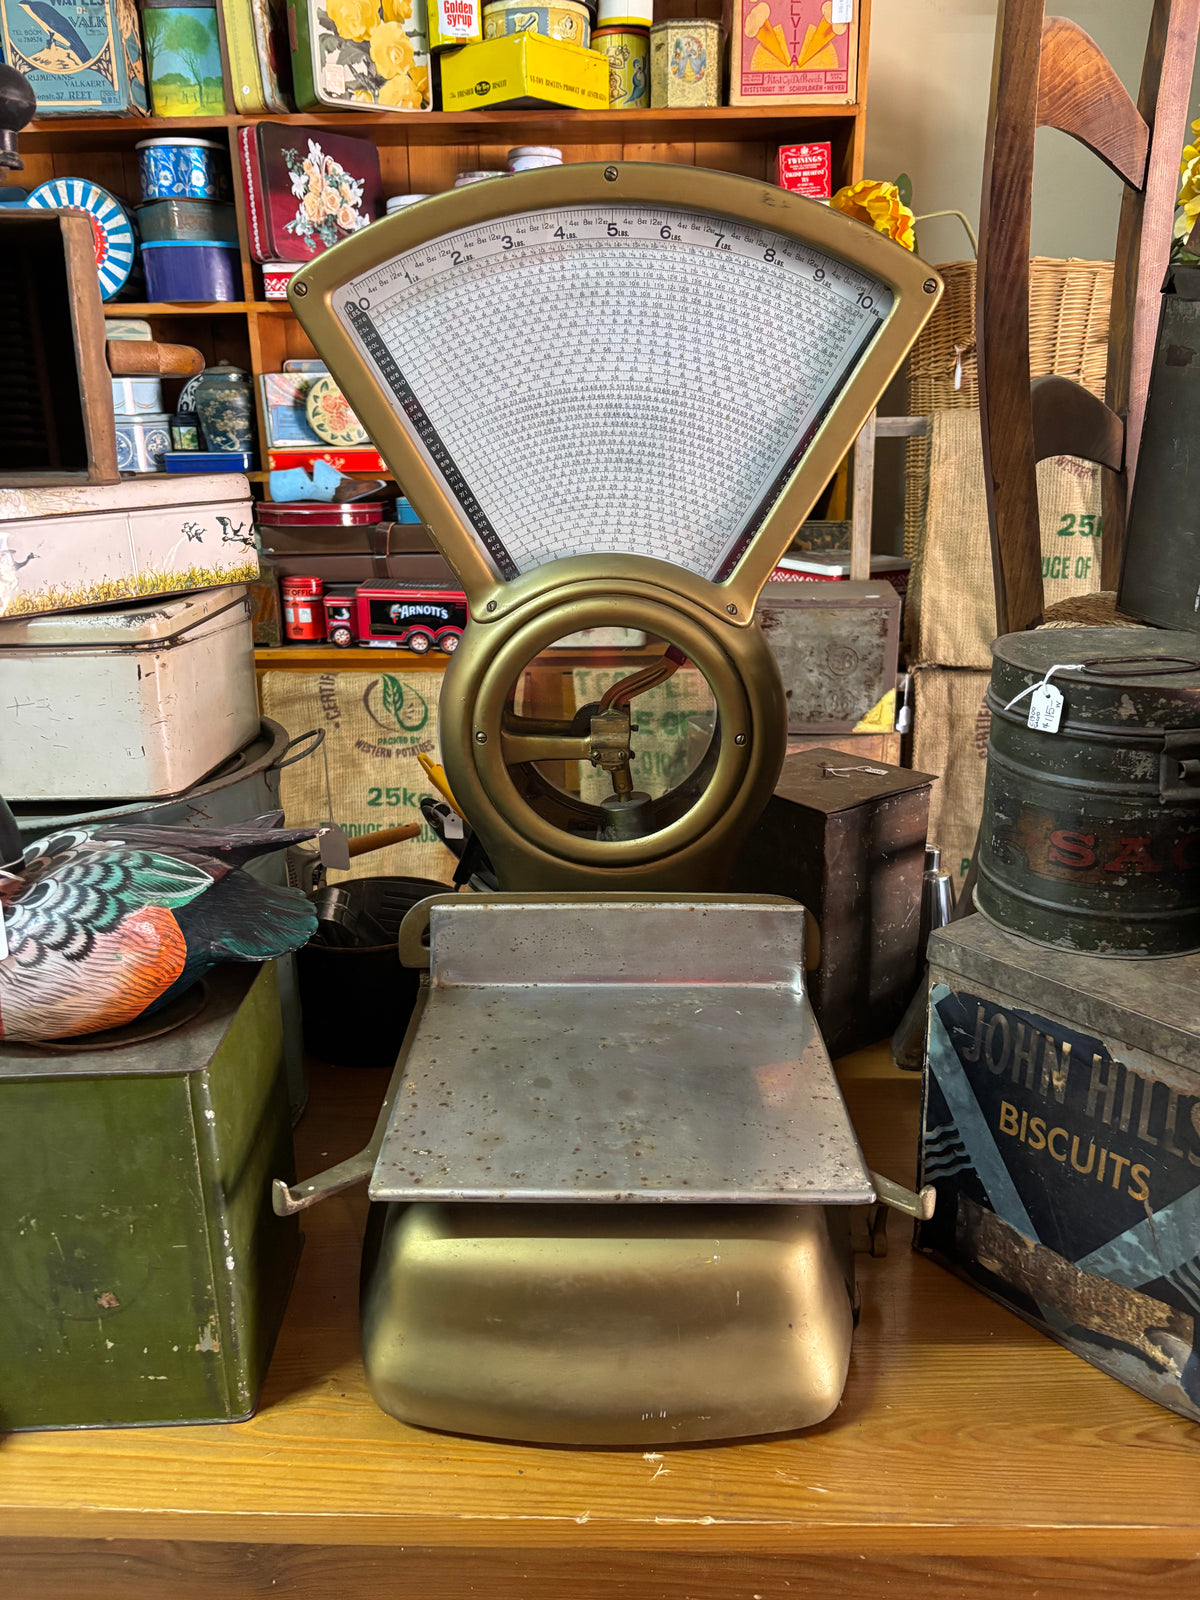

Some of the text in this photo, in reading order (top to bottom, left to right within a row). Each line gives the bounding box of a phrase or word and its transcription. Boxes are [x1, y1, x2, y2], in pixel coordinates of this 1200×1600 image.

[443, 0, 473, 15] Golden
[68, 16, 107, 28] VALK
[446, 14, 472, 28] syrup
[790, 0, 801, 66] LVITA
[69, 91, 92, 100] REET
[787, 156, 822, 164] TWININGS
[554, 226, 565, 239] 4
[607, 223, 618, 236] 5
[660, 226, 672, 239] 6
[501, 236, 514, 249] 3
[714, 233, 725, 247] 7
[450, 251, 463, 266] 2
[763, 248, 776, 262] 8
[405, 272, 412, 284] 1
[813, 269, 825, 281] 9
[359, 298, 370, 310] 0
[856, 292, 873, 309] 10
[1075, 556, 1091, 578] OF
[400, 605, 449, 619] ARNOTT'S
[377, 736, 421, 745] PACKED BY
[355, 739, 435, 758] WESTERN POTATOES
[962, 1004, 1072, 1105] JOHN
[1000, 1100, 1151, 1201] BISCUITS
